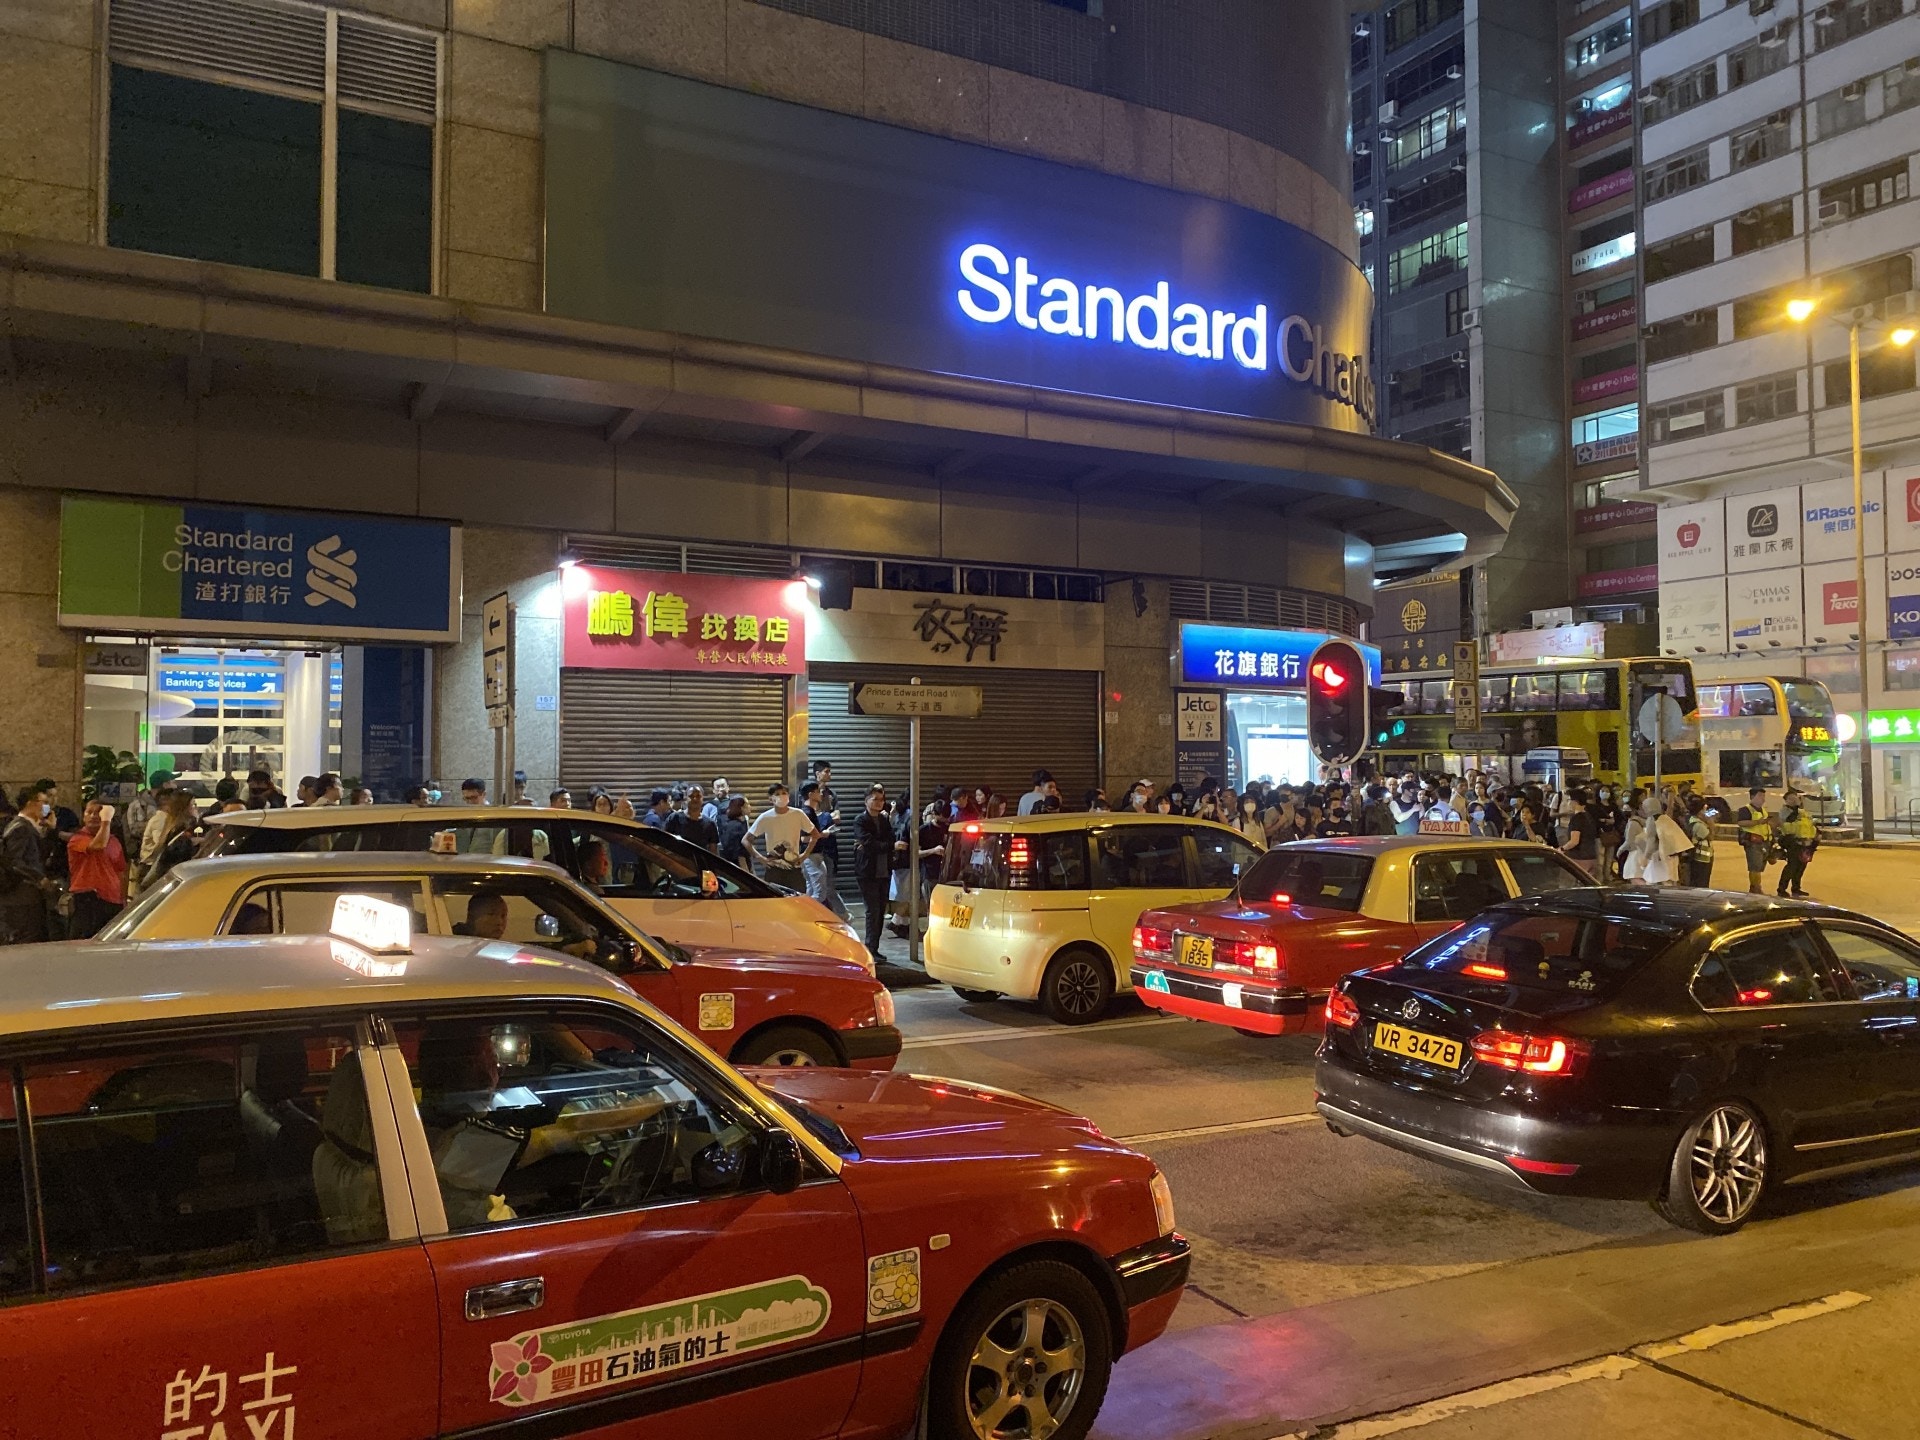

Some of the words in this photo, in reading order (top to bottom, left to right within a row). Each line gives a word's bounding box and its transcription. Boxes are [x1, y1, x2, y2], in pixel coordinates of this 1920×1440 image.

[957, 243, 1267, 371] Standard
[174, 524, 293, 552] Standard
[162, 550, 292, 578] Chartered
[195, 581, 292, 605] 渣打銀行
[1753, 586, 1790, 598] EMMAS
[587, 590, 789, 642] 鵬偉找換店
[1215, 648, 1300, 678] 花旗銀行
[165, 677, 204, 689] Banking
[207, 678, 247, 689] Sevices
[866, 687, 891, 697] Prince
[894, 687, 925, 698] Edward
[926, 688, 948, 698] Road
[896, 701, 942, 712] 太子道西
[1181, 696, 1218, 712] Jetco
[1205, 721, 1212, 732] $
[1869, 716, 1920, 738] 恒生
[1179, 751, 1189, 762] 24
[1422, 820, 1460, 833] TAXI
[950, 918, 969, 929] 4027
[1191, 940, 1206, 953] SZ
[1185, 951, 1209, 967] 1835
[1153, 976, 1159, 984] 4
[1568, 980, 1596, 988] BABY
[1381, 1027, 1400, 1049] VR
[1407, 1034, 1456, 1063] 3478
[560, 1328, 591, 1340] TOYOTA
[550, 1331, 731, 1394] 豐田石油氣的士
[163, 1352, 297, 1426] 的士
